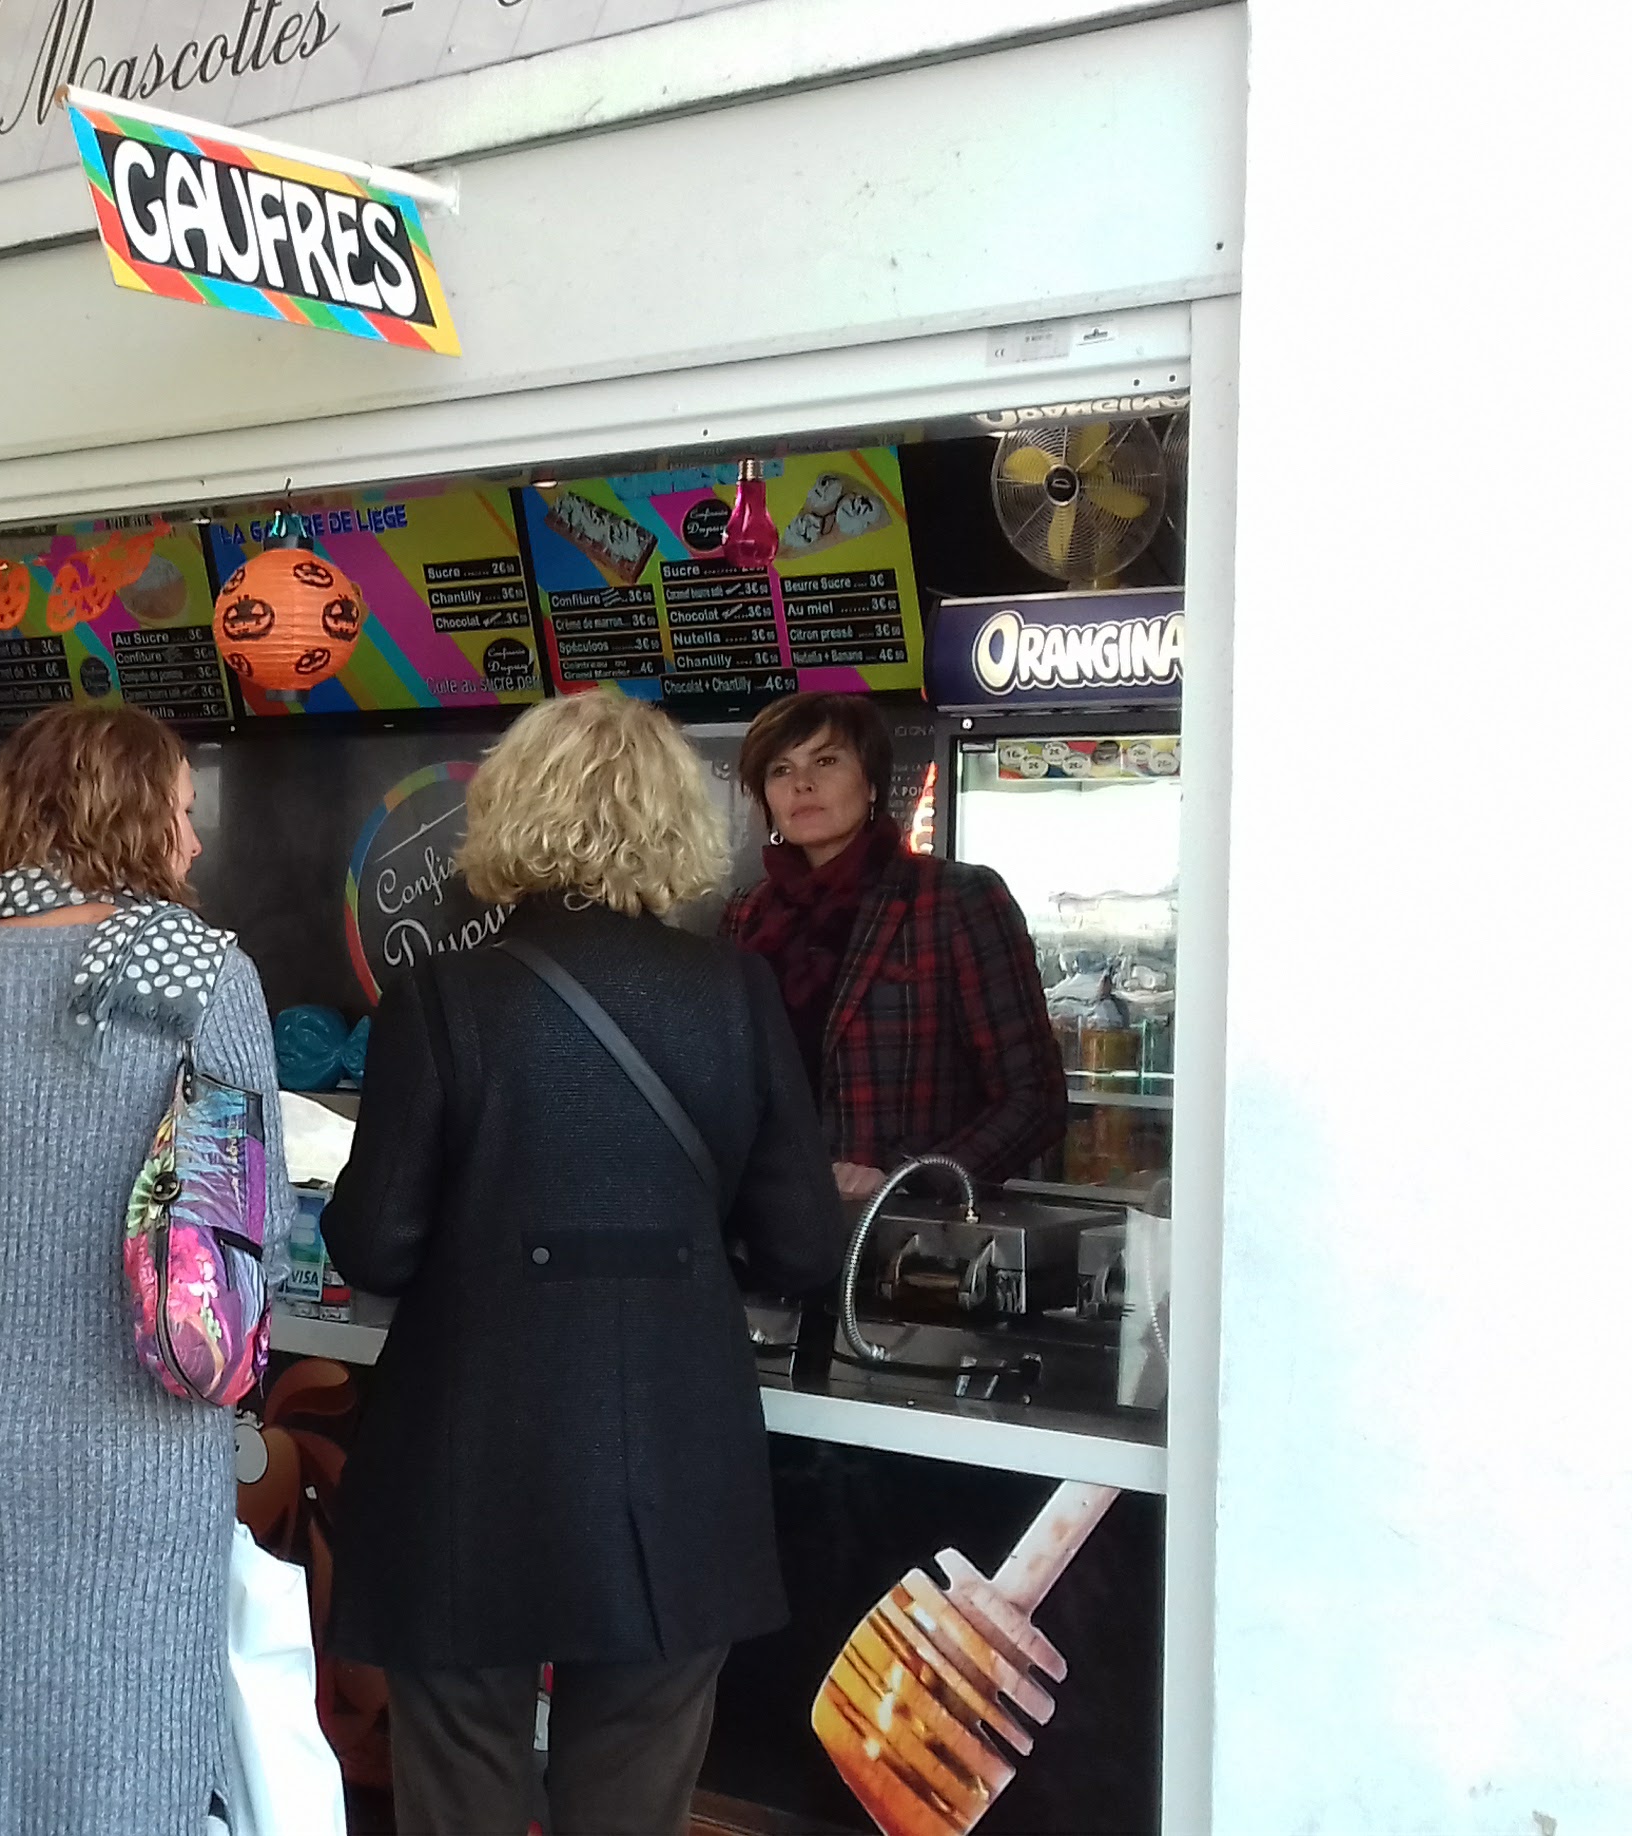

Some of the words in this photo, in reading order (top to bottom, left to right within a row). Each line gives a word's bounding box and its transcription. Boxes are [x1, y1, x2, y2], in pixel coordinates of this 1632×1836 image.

[113, 139, 420, 318] GAUFRES
[328, 510, 353, 533] DE
[428, 567, 461, 579] Sucre
[663, 565, 700, 578] Sucre
[784, 580, 819, 593] Beurre
[820, 576, 851, 590] Sucre
[869, 573, 885, 588] 3€
[431, 589, 482, 605] Chantilly
[551, 593, 601, 608] Confiture
[670, 607, 720, 623] Chocolat
[787, 603, 804, 617] Au
[807, 599, 834, 615] miel
[435, 615, 481, 629] Chocolat
[582, 617, 593, 629] de
[115, 634, 131, 647] Au
[134, 632, 169, 644] Sucre
[188, 628, 203, 641] 3€
[673, 630, 721, 646] Nutella
[789, 628, 819, 642] Citron
[820, 624, 853, 642] pressé
[558, 640, 609, 656] Spéculoos
[974, 611, 1185, 695] ORANGINA
[116, 650, 162, 664] Confiture
[676, 653, 732, 669] Chantilly
[383, 903, 517, 968] Dupu
[291, 1269, 319, 1286] VISA
